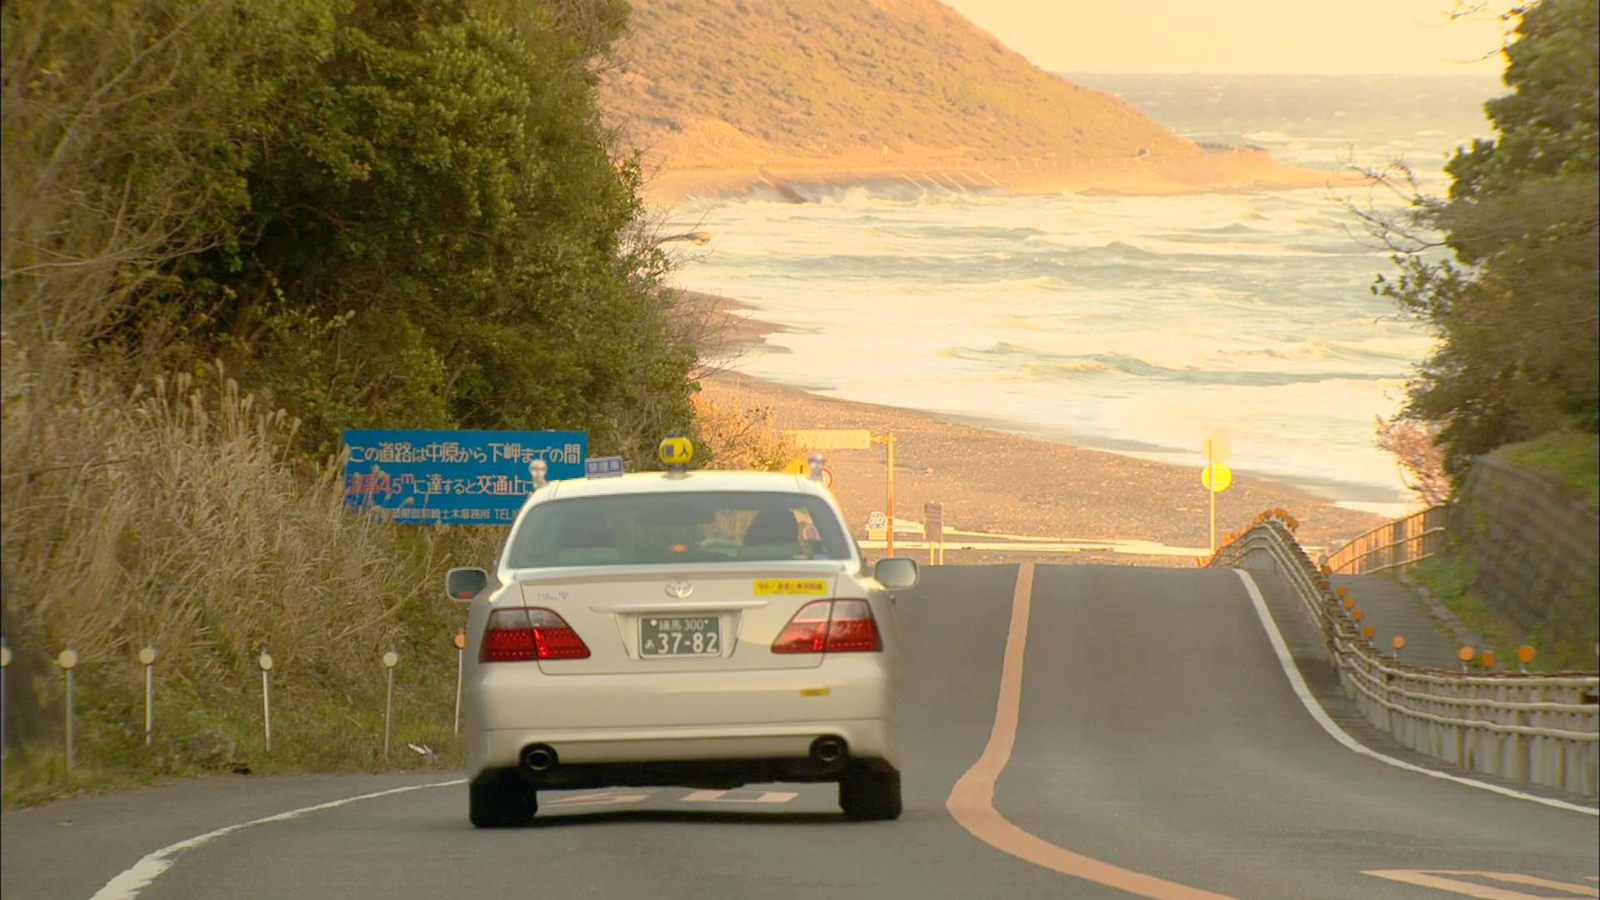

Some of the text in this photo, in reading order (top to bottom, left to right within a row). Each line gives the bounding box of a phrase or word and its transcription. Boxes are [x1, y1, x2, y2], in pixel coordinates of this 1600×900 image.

[348, 441, 581, 465] この道路は中原から下岬までの間
[684, 619, 704, 631] 300
[657, 632, 718, 654] 37-82
